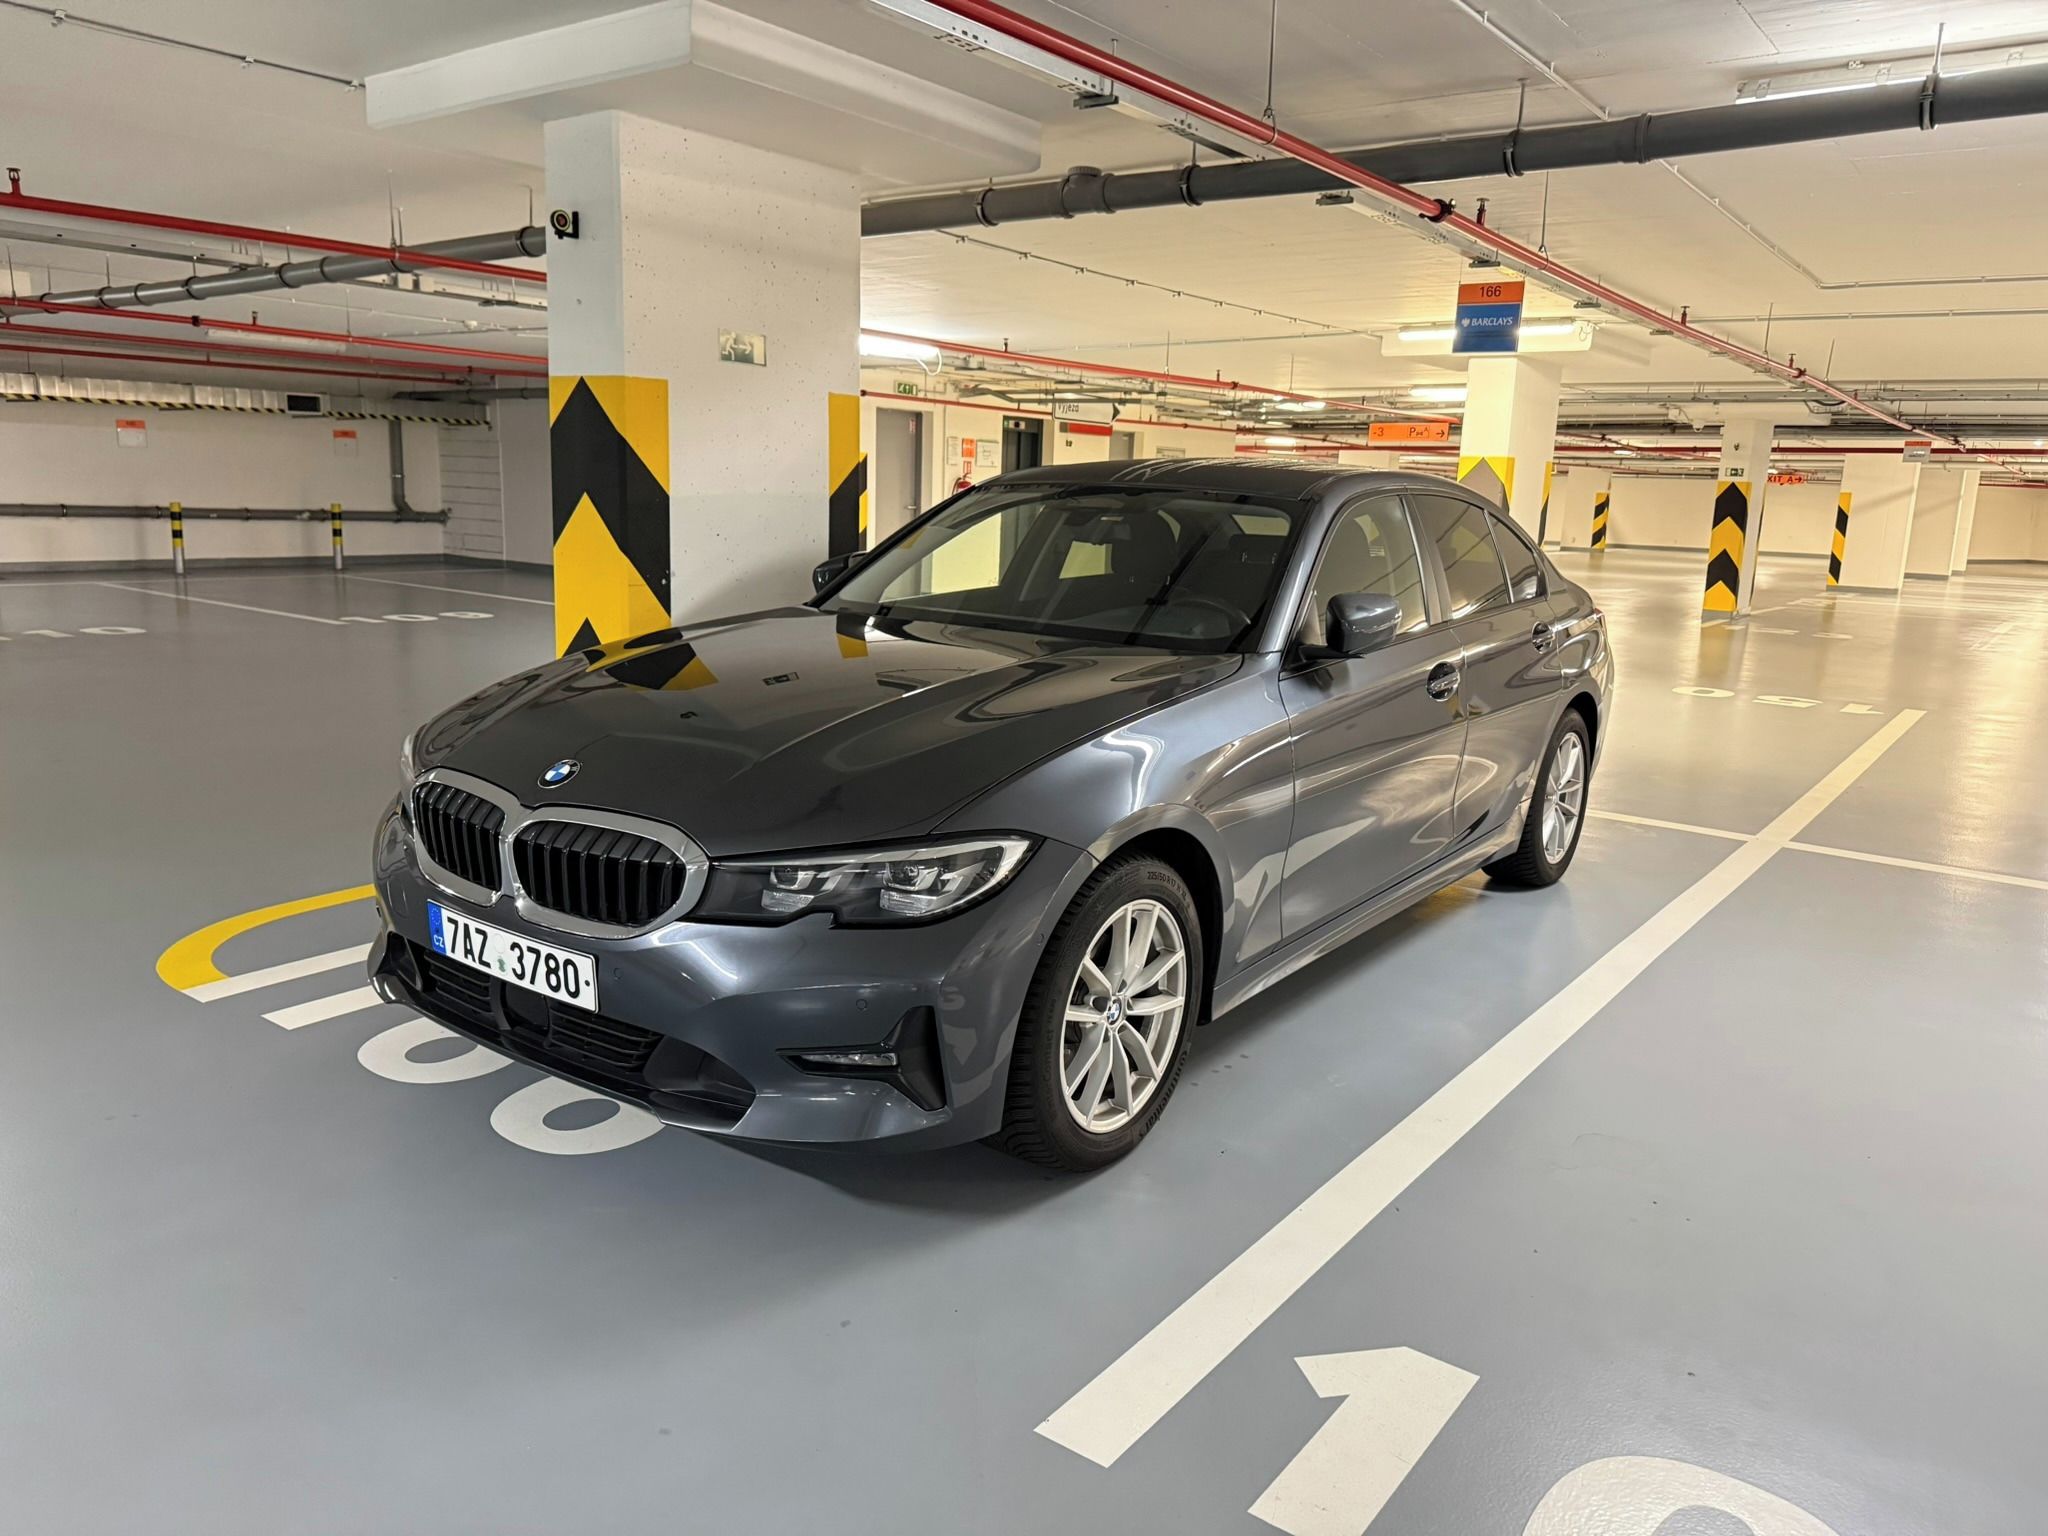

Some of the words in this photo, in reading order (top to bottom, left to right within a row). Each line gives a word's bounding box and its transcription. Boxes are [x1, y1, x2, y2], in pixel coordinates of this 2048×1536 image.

[1479, 285, 1502, 298] 166
[1471, 316, 1514, 327] BARCLAYS
[1767, 475, 1784, 483] XIT
[0, 626, 148, 641] 10
[1671, 687, 1884, 715] 150
[433, 934, 445, 948] CZ
[446, 915, 492, 970] 7AZ
[510, 941, 581, 1000] 3780
